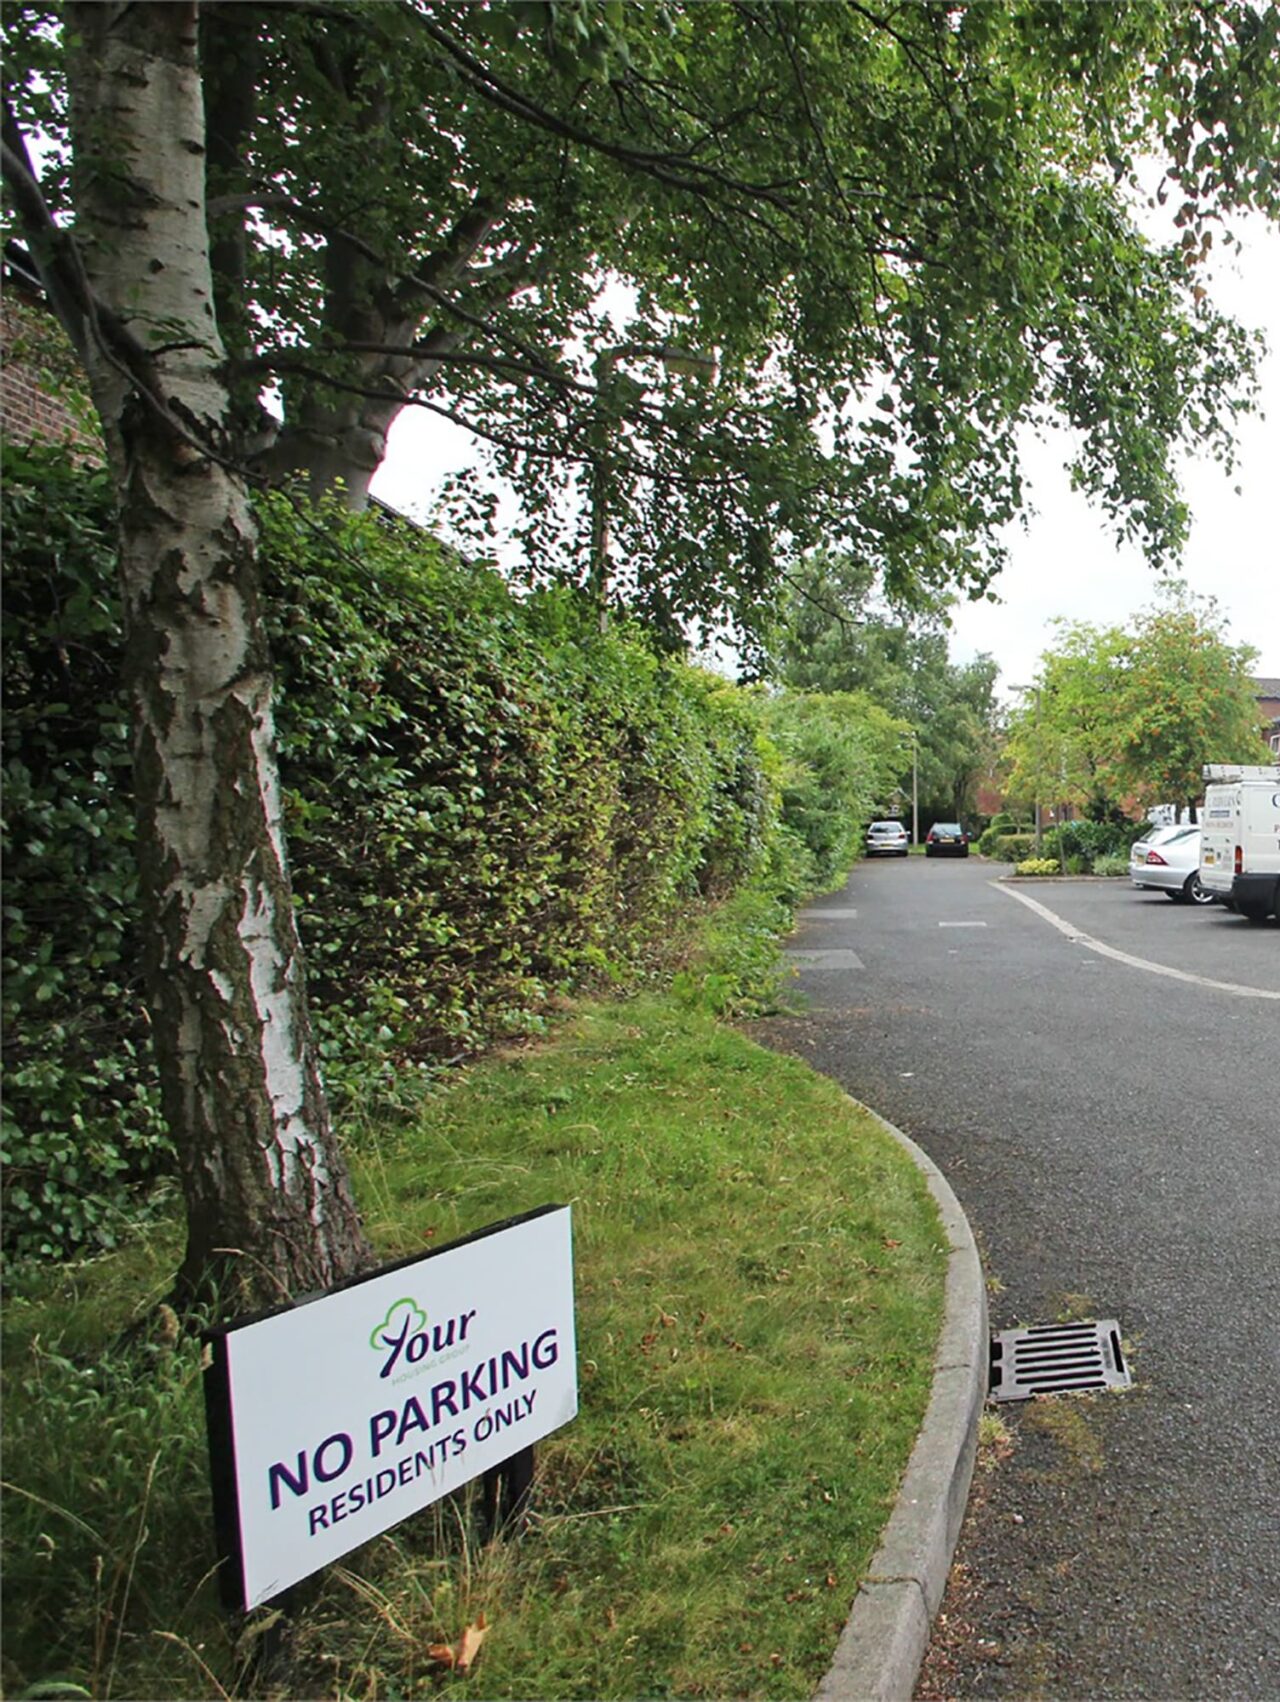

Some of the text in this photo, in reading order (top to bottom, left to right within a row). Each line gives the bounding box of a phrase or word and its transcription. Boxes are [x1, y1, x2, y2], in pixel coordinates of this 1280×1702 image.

[380, 1309, 477, 1379] Your
[267, 1328, 559, 1511] NO PARKING
[307, 1388, 538, 1537] RESIDENTS ONLY
